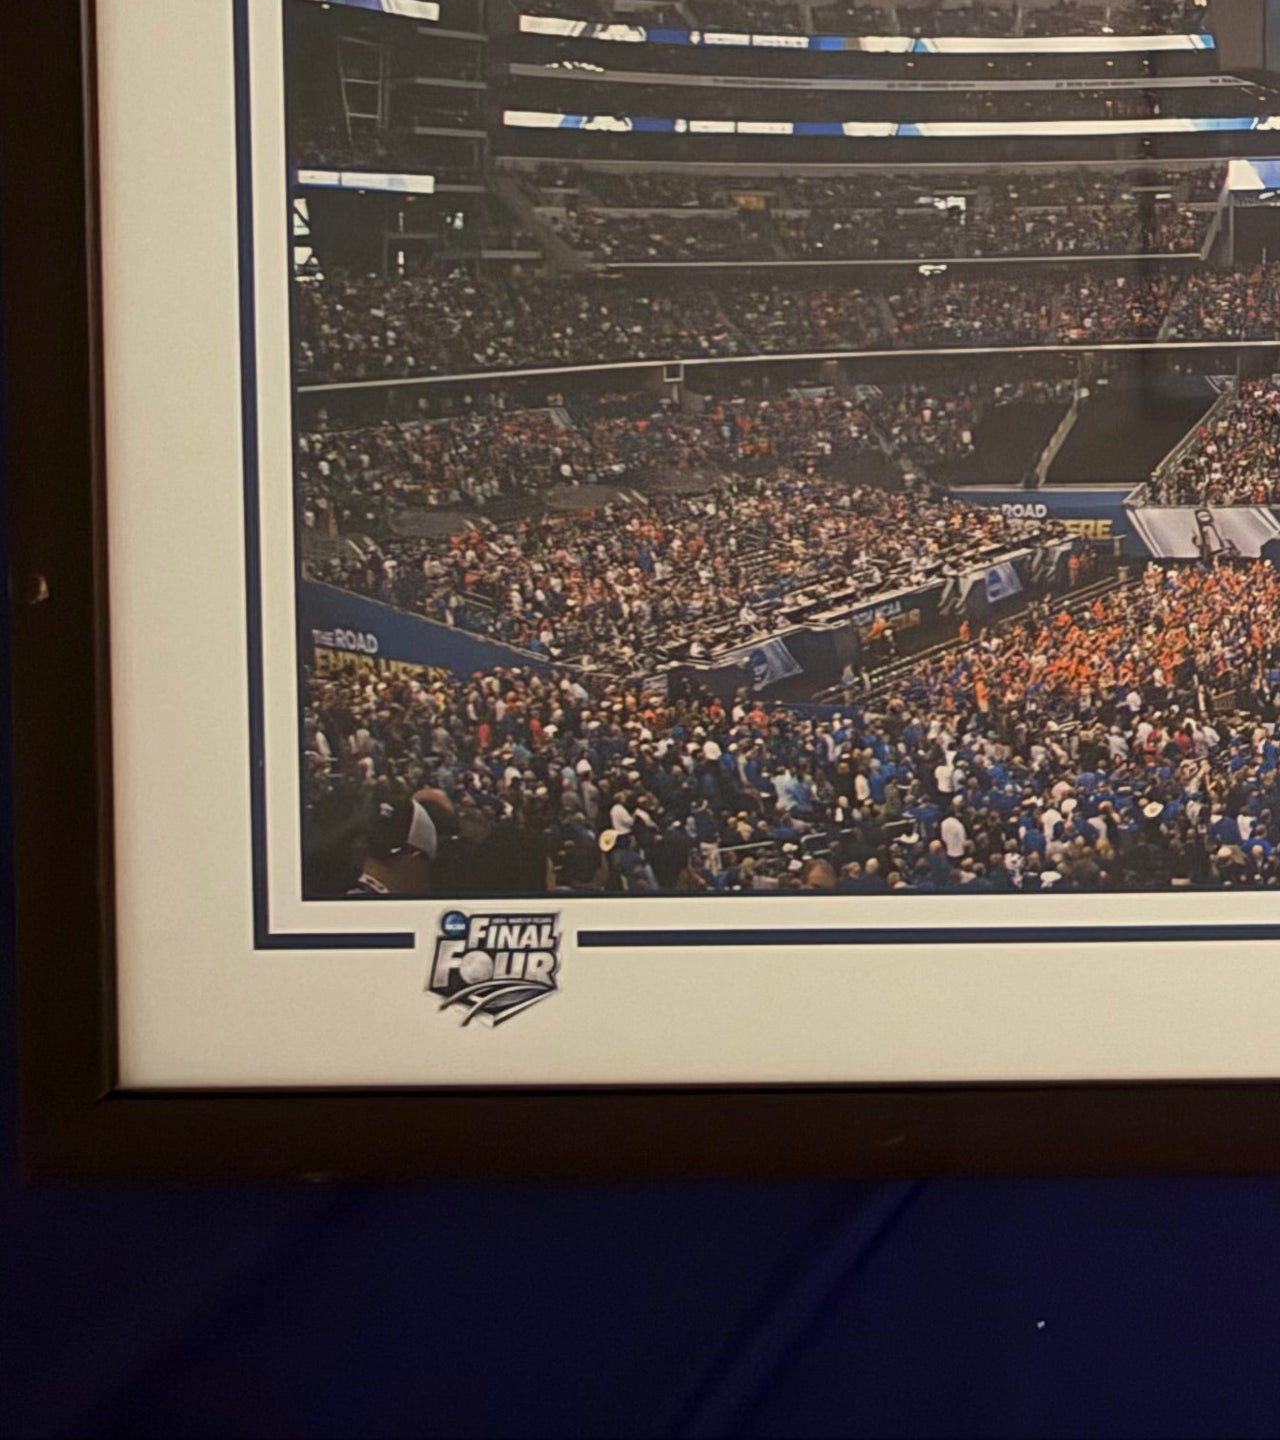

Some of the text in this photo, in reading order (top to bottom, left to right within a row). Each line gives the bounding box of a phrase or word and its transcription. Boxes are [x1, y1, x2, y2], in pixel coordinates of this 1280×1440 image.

[333, 629, 379, 654] ROAD
[467, 917, 555, 950] FINAL
[432, 939, 557, 989] FOUR
